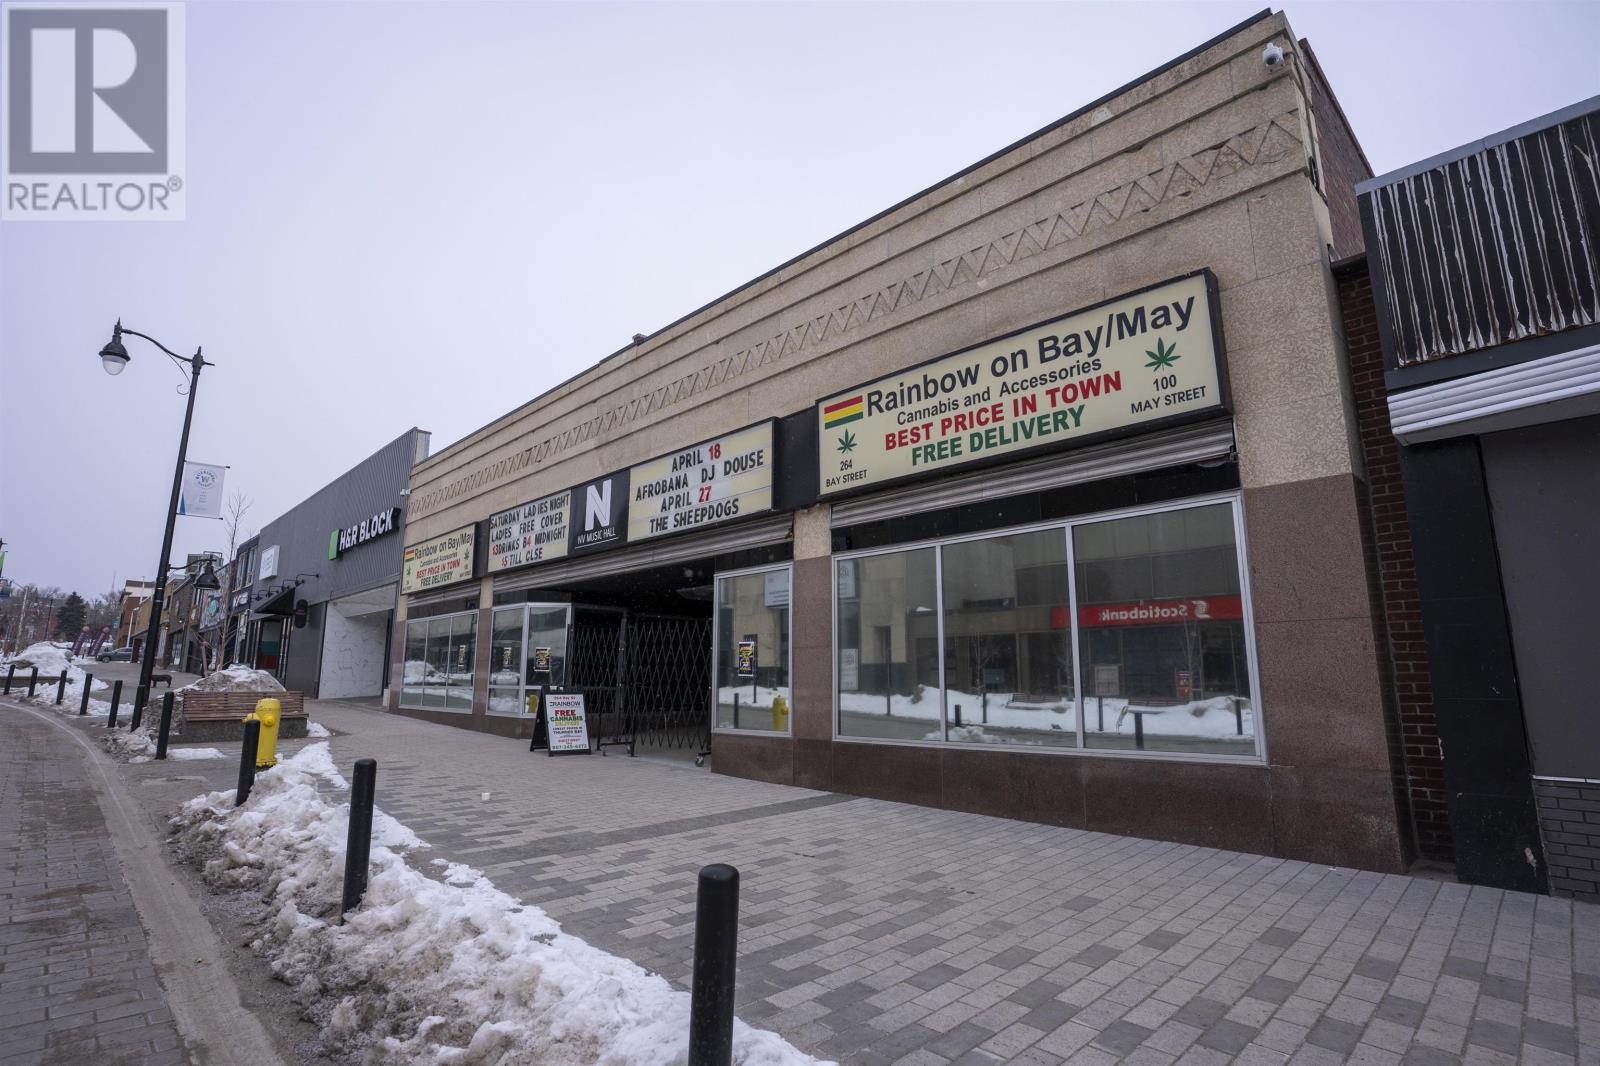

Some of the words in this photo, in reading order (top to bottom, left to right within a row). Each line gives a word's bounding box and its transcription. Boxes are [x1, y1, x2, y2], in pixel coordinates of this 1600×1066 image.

[866, 361, 981, 417] Rainbow
[990, 349, 1029, 378] on
[1038, 296, 1195, 365] Bay/May
[896, 397, 960, 426] Cannabis
[964, 387, 991, 407] and
[999, 357, 1102, 398] Accessories
[1152, 374, 1178, 392] 100
[885, 422, 933, 451] BEST
[941, 403, 1004, 438] PRICE
[1013, 393, 1038, 418] IN
[1046, 371, 1122, 408] TOWN
[1131, 396, 1161, 415] MAY
[1163, 385, 1207, 407] STREET
[911, 433, 963, 466] FREE
[969, 404, 1086, 454] DELIVERY
[671, 449, 703, 472] APRIL
[708, 443, 721, 461] 18
[839, 458, 854, 471] 264
[635, 473, 689, 501] AFROBANA
[701, 465, 715, 483] DJ
[723, 449, 764, 476] DOUSE
[825, 474, 842, 488] BAY
[842, 469, 868, 484] STREET
[490, 510, 521, 529] SATURDAY
[549, 494, 570, 511] NIGHT
[584, 480, 612, 532] N
[661, 491, 692, 513] APRIL
[698, 486, 712, 503] 27
[339, 525, 358, 551] H&R
[359, 507, 394, 543] BLOCK
[491, 526, 512, 542] LADIES
[519, 519, 535, 535] FREE
[540, 512, 563, 528] COVER
[650, 515, 669, 533] THE
[673, 498, 739, 528] SHEEPDOGS
[415, 544, 438, 560] Rainbow
[439, 541, 447, 552] on
[577, 535, 586, 545] NV
[586, 530, 603, 542] MUSIC
[603, 527, 616, 537] HALL
[416, 569, 427, 579] BEST
[428, 565, 440, 576] PRICE
[441, 563, 446, 572] IN
[447, 558, 461, 570] TOWN
[509, 554, 522, 566] TILL
[420, 576, 431, 587] FREE
[431, 571, 454, 585] DELIVERY
